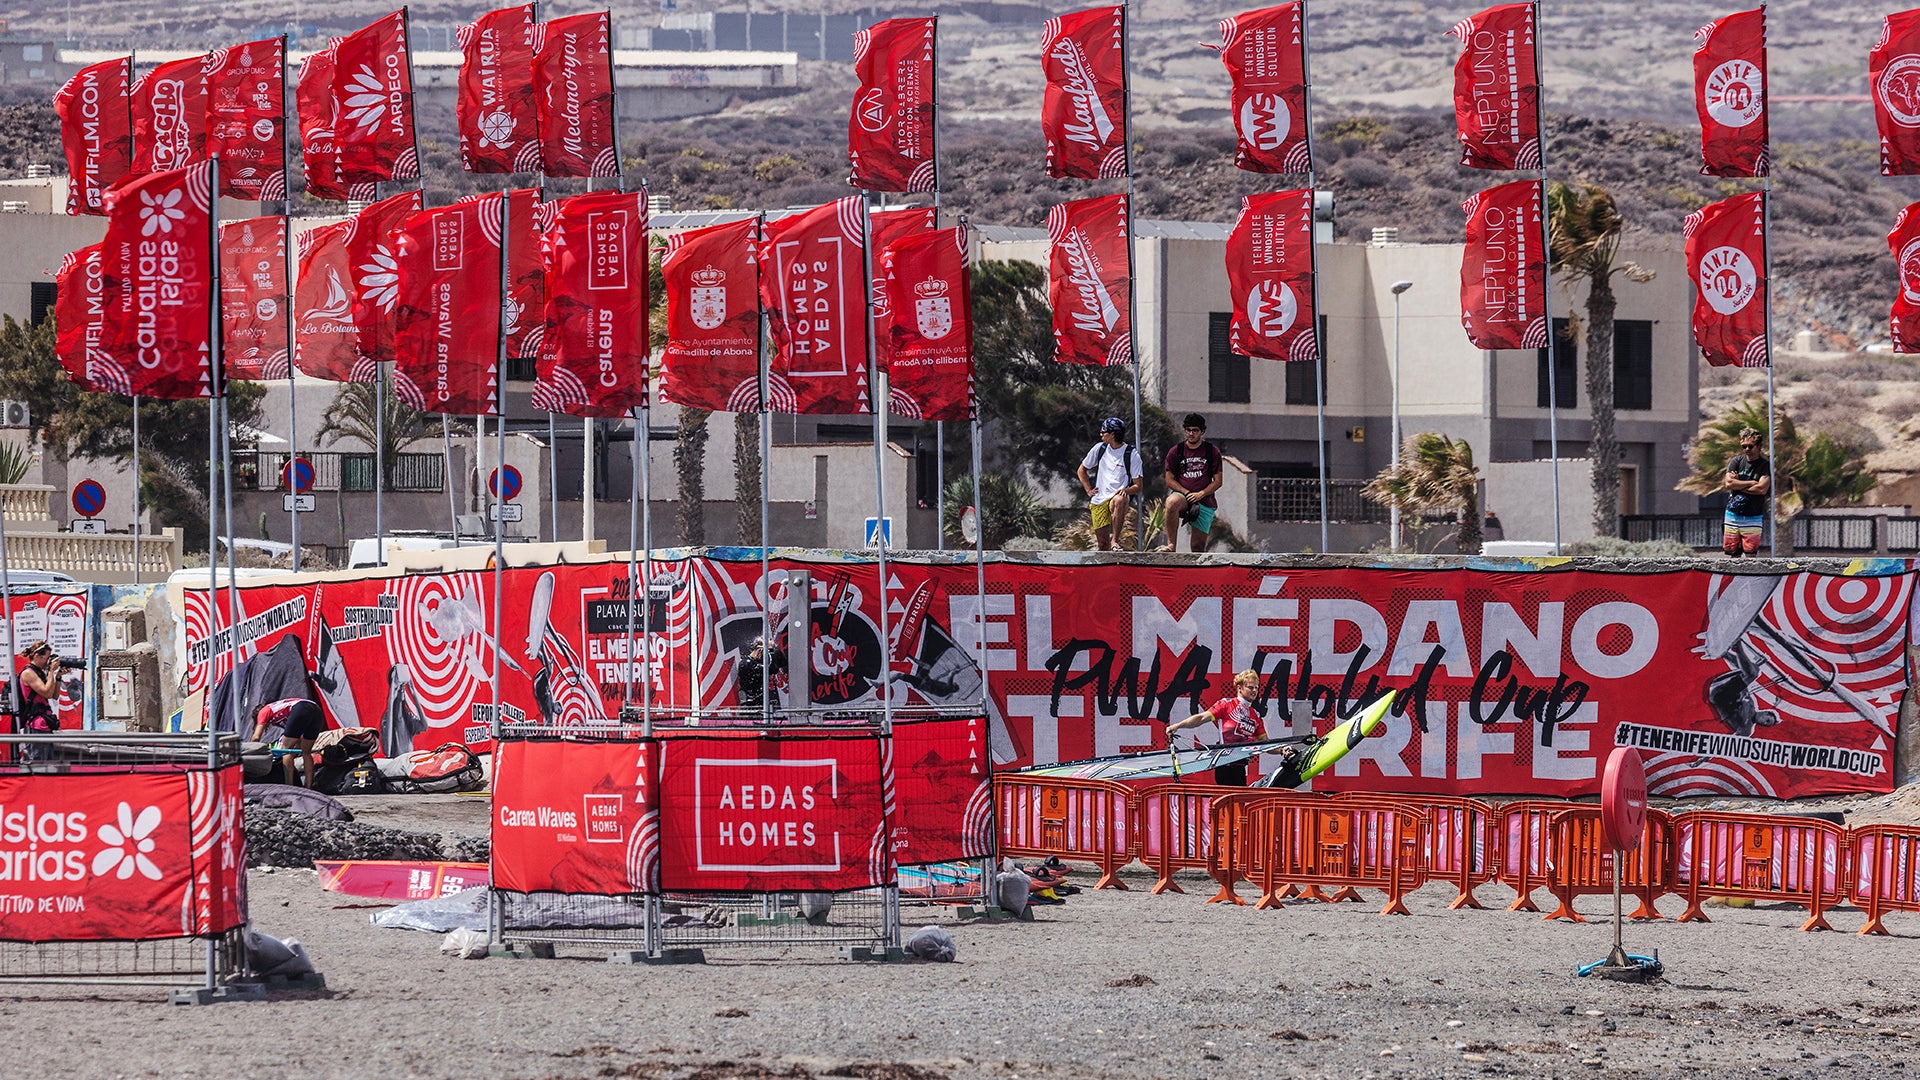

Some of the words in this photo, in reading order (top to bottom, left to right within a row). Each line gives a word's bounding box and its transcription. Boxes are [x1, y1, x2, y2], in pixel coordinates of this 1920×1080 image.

[226, 67, 250, 76] GROUP
[1244, 29, 1254, 78] TENERIFE
[1255, 28, 1265, 78] WINDSURF
[1267, 27, 1278, 77] SOLUTION
[1498, 30, 1509, 85] away
[385, 54, 404, 137] JARDECO
[561, 32, 584, 160] Medano4you
[897, 59, 906, 120] CABRERA
[906, 59, 914, 103] SCIENCE
[1473, 31, 1500, 145] NEPTUNO
[152, 79, 178, 173] ICACHO
[1500, 98, 1510, 144] take
[226, 247, 251, 255] GROUP
[1252, 214, 1261, 265] TENERIFE
[1264, 214, 1274, 265] WINDSURF
[1276, 213, 1286, 264] SOLUTION
[1507, 206, 1518, 262] away
[1091, 253, 1104, 273] SOUL
[1482, 207, 1506, 323] NEPTUNO
[1507, 275, 1517, 322] take
[668, 346, 709, 357] Granadilla
[710, 347, 722, 356] de
[723, 347, 753, 356] Abona
[692, 336, 753, 348] Ayuntamiento
[596, 604, 627, 619] PLAYA
[908, 589, 927, 624] BRUCH
[949, 594, 1090, 671] EL
[1132, 576, 1660, 679] MÉDANO
[332, 625, 358, 642] REALIDAD
[588, 639, 605, 660] EL
[607, 632, 667, 660] MÉDANO
[596, 661, 661, 684] TENERIFE
[1045, 637, 1212, 723] PWA
[1469, 650, 1590, 748] Cup
[473, 704, 502, 722] DEPORE
[1616, 722, 1881, 776] #TENERIFEWINDSURFWORLDCUP
[500, 805, 536, 828] Carena
[538, 806, 577, 828] Waves
[592, 804, 617, 817] AEDAS
[719, 785, 815, 810] AEDAS
[592, 820, 618, 833] HOMES
[719, 821, 815, 847] HOMES
[38, 896, 53, 914] DE
[56, 895, 85, 914] VIDA
